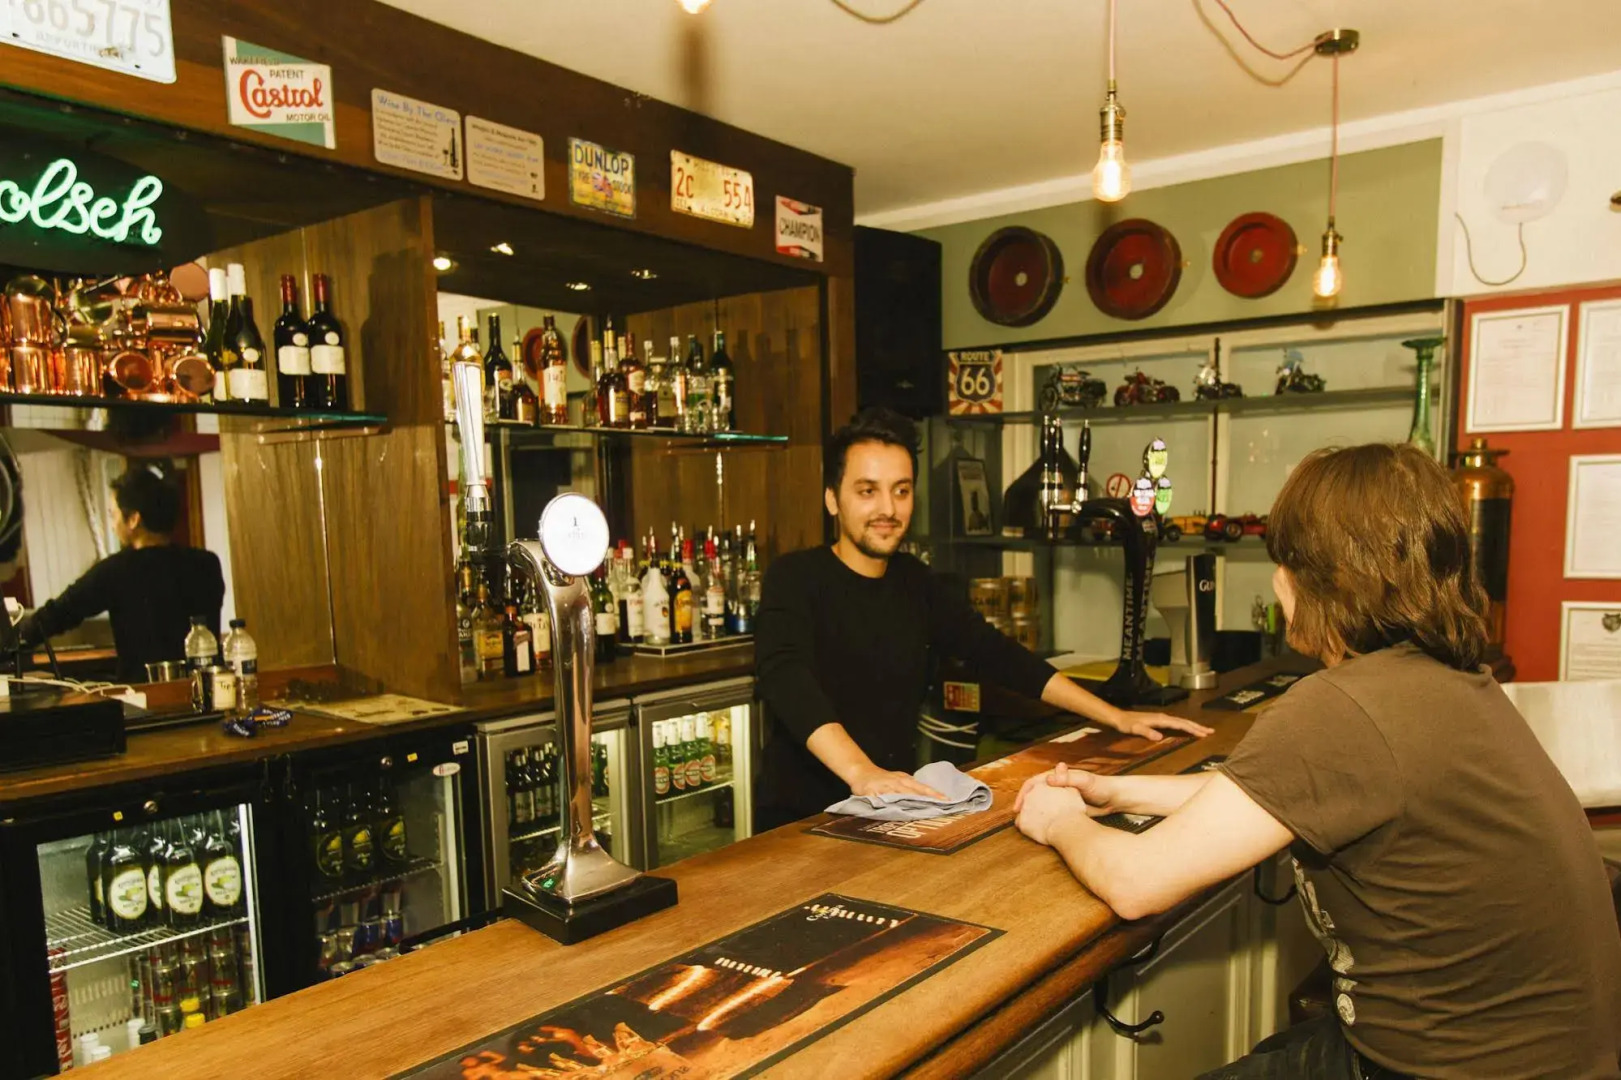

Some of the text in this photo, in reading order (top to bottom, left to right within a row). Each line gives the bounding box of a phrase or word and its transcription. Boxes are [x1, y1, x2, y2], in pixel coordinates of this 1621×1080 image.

[268, 69, 305, 80] PATENT
[239, 68, 324, 119] Castrol
[286, 113, 331, 122] MOTOR OIL
[574, 143, 630, 176] DUNLOP
[779, 216, 821, 243] CHAMPION
[960, 352, 991, 362] ROUTE
[960, 367, 991, 396] 66
[1122, 570, 1135, 661] MEANTIME
